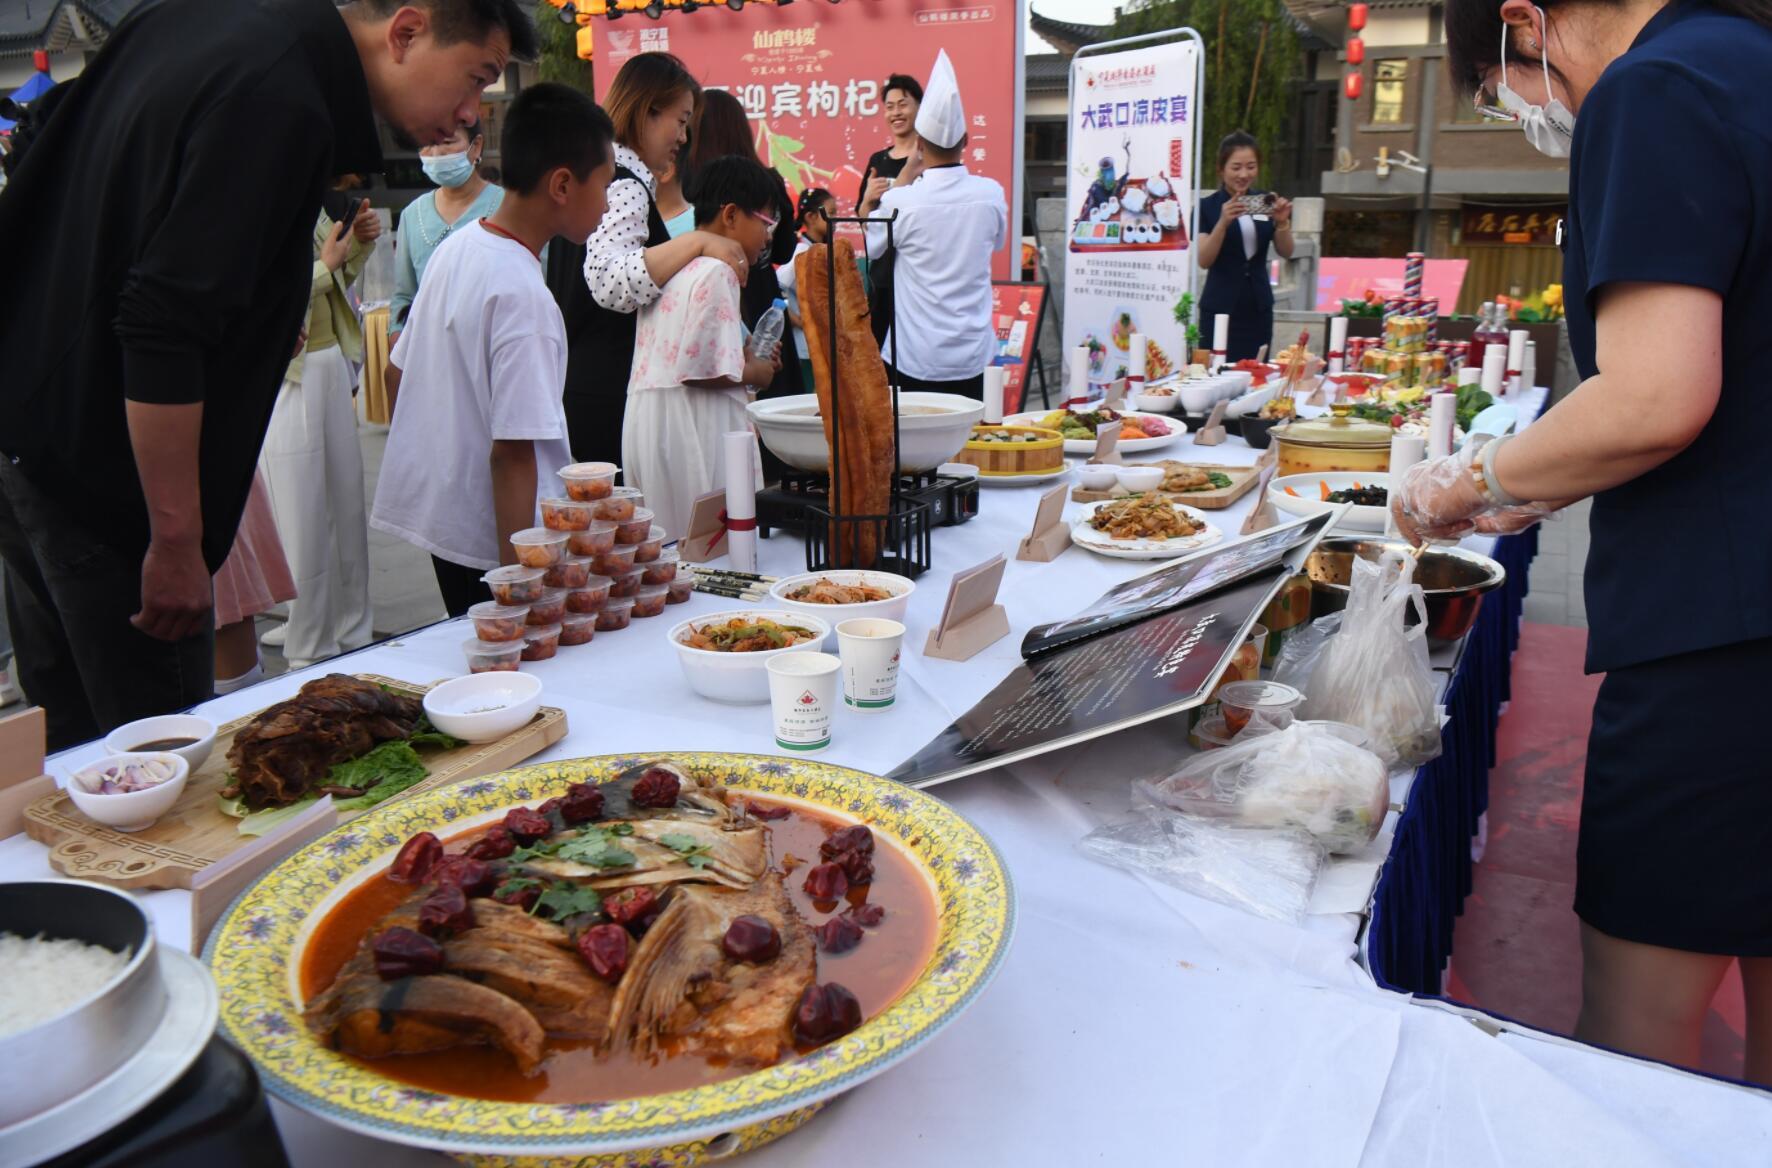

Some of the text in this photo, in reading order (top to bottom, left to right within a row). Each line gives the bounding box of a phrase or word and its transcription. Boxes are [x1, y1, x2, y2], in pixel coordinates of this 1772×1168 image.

[753, 28, 816, 49] 仙鹤楼
[1081, 94, 1188, 129] 大武口凉皮宴
